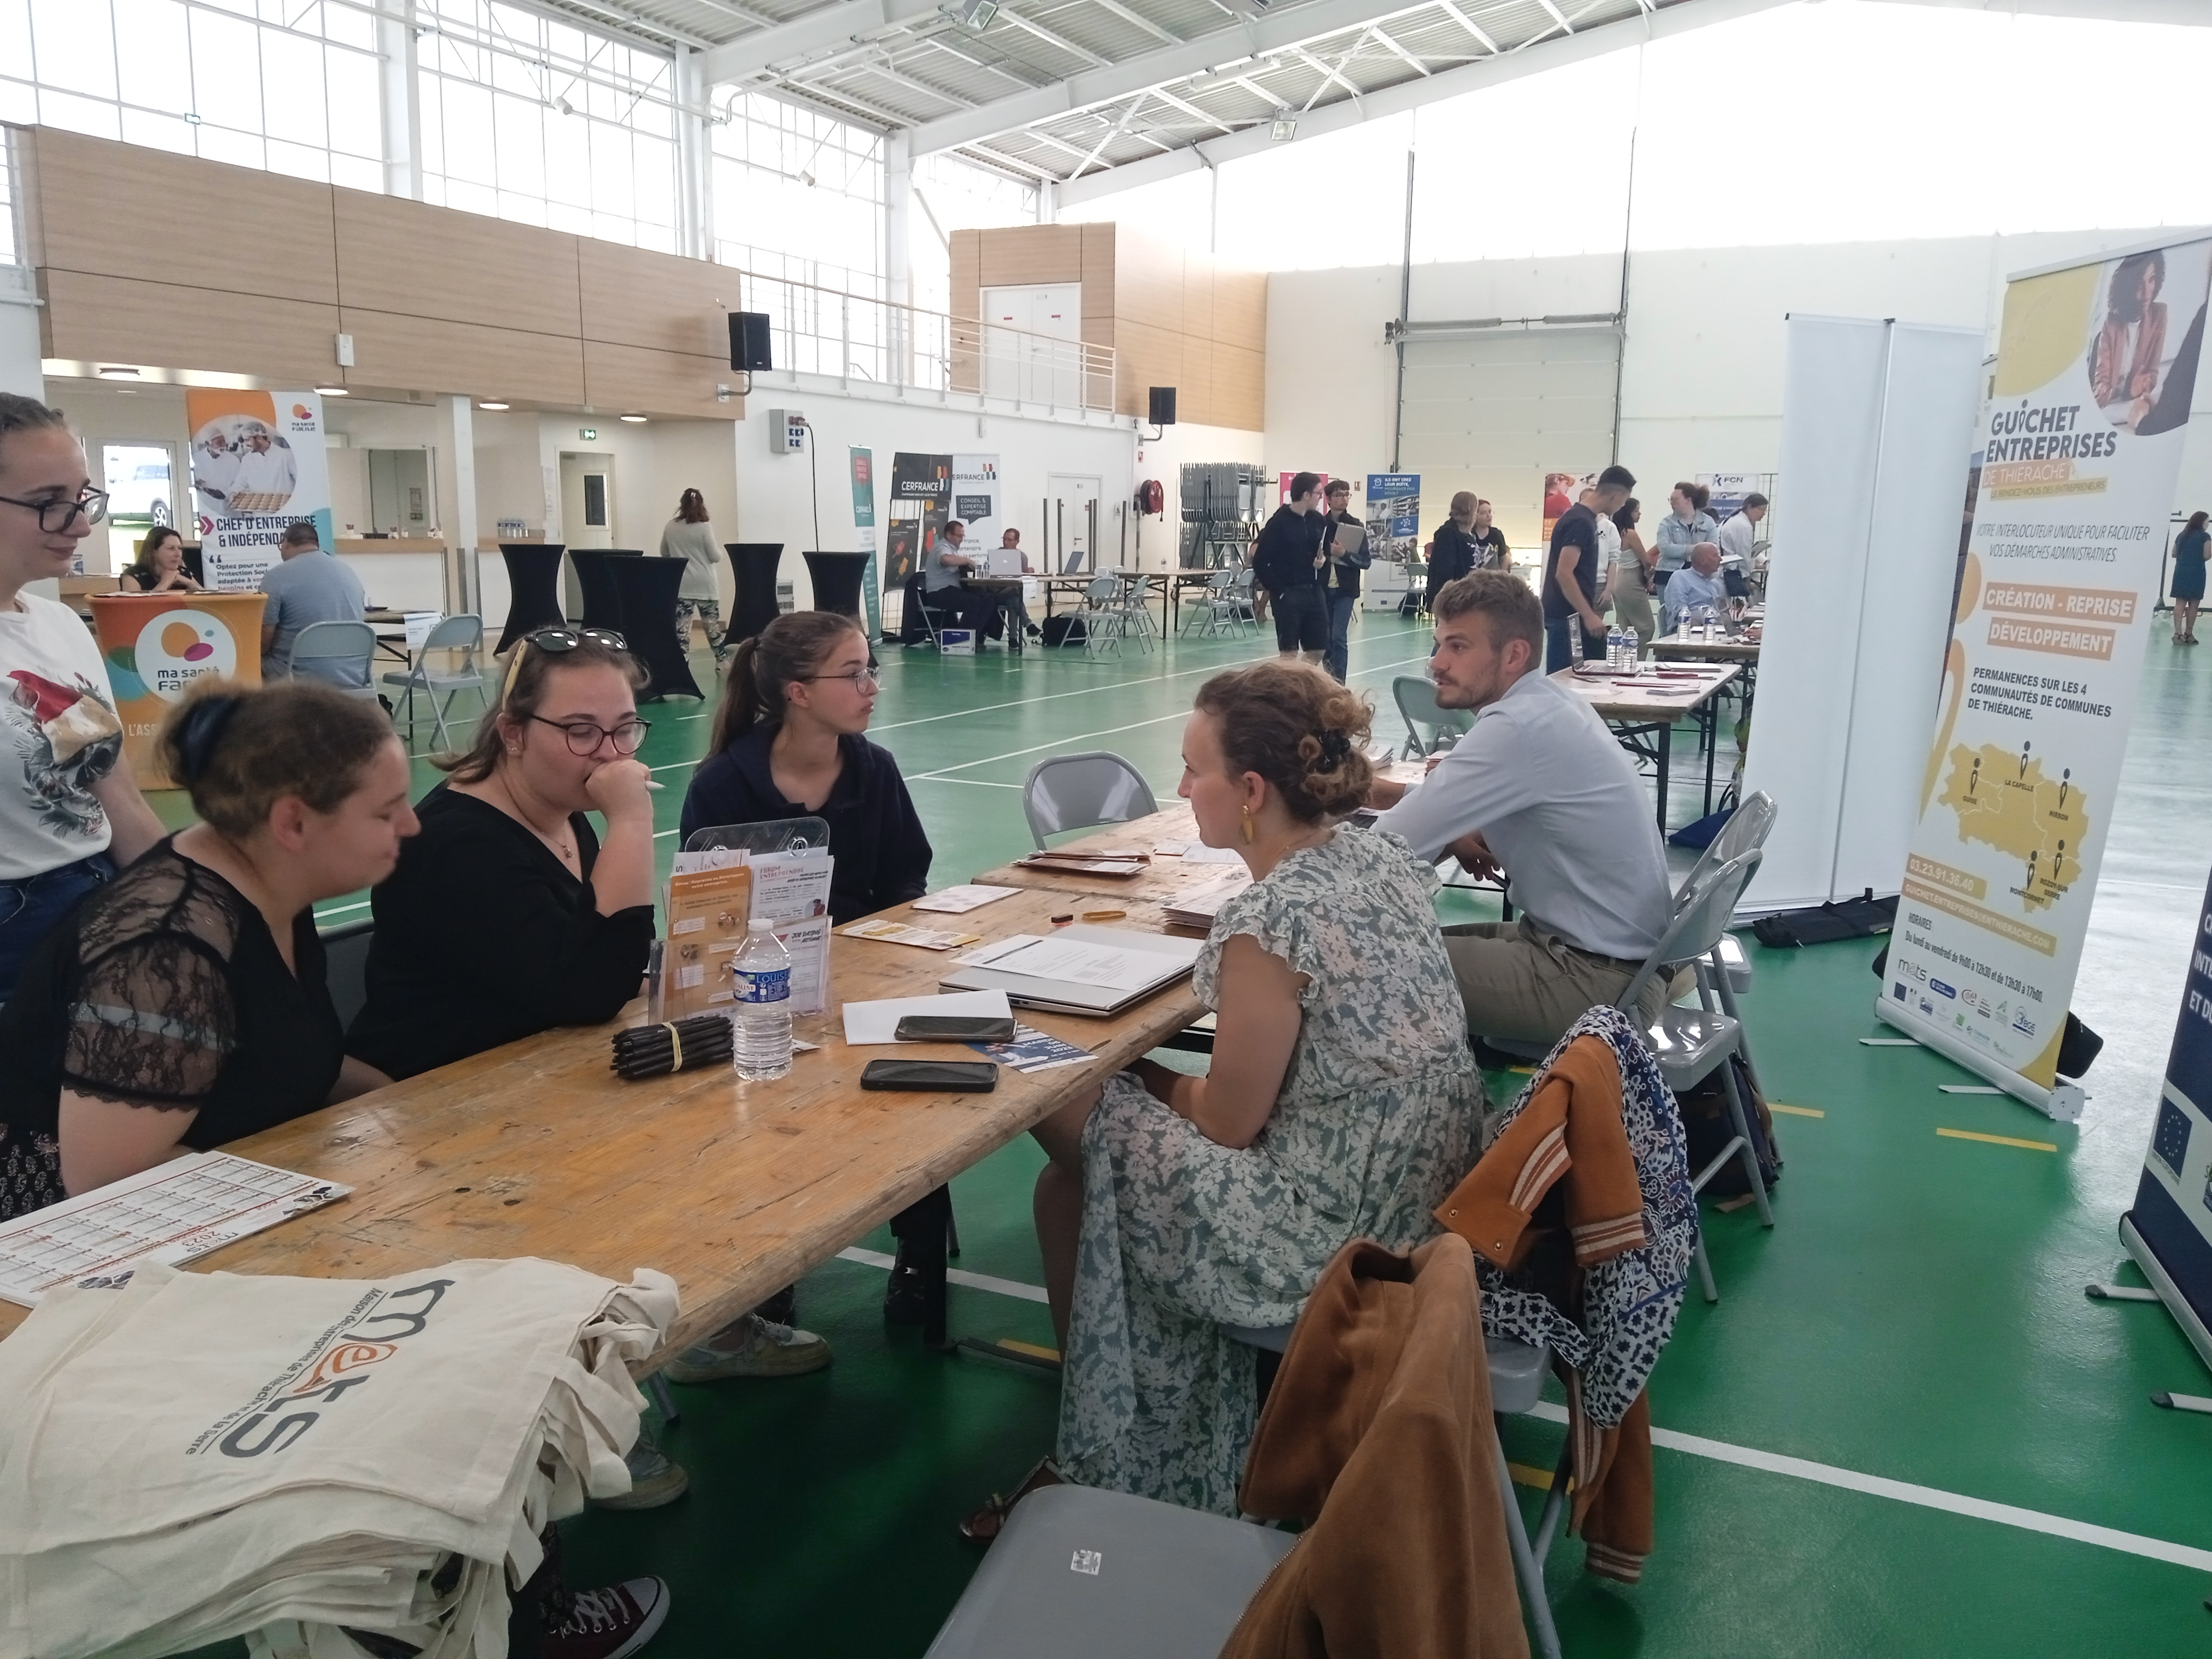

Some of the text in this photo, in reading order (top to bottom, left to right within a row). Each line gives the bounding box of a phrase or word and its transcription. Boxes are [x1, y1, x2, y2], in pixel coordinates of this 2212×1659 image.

[1986, 431, 2117, 463] ENTREPRISES
[1983, 462, 2067, 486] DE THIÉRACHE
[901, 481, 939, 491] CERFRANCE
[216, 518, 243, 531] CHEF
[1997, 524, 2054, 538] INTERLOCUTEUR
[2054, 524, 2085, 539] UNIQUE
[2085, 525, 2106, 539] POUR
[2107, 525, 2150, 541] FACILITER
[219, 535, 226, 547] &
[1990, 543, 2004, 557] VOS
[2004, 542, 2050, 559] DÉMARCHES
[1986, 587, 2055, 610] CRÉATION
[2066, 595, 2133, 617] REPRISE
[1990, 621, 2112, 653] DÉVELOPPEMENT
[1973, 667, 2087, 696] PERMANENCES SUR LES 4
[1968, 698, 2033, 720] DE THIÉRACHE.
[1971, 683, 2112, 718] COMMUNAUTÉS DE COMMUNES
[2012, 781, 2035, 792] CAPELLE
[2049, 810, 2069, 822] HIRSON
[760, 868, 804, 879] ENTREPRENDRE
[1909, 858, 1974, 892] 03.23.91.36.40
[2009, 886, 2045, 904] MONTCORNET
[1905, 930, 1912, 942] Du
[2189, 990, 2202, 1014] ET
[2023, 1019, 2036, 1032] BGE
[181, 1230, 220, 1247] 2023
[350, 1287, 383, 1316] Maison
[287, 1357, 302, 1372] de
[213, 1420, 226, 1429] la
[186, 1430, 219, 1455] Serre
